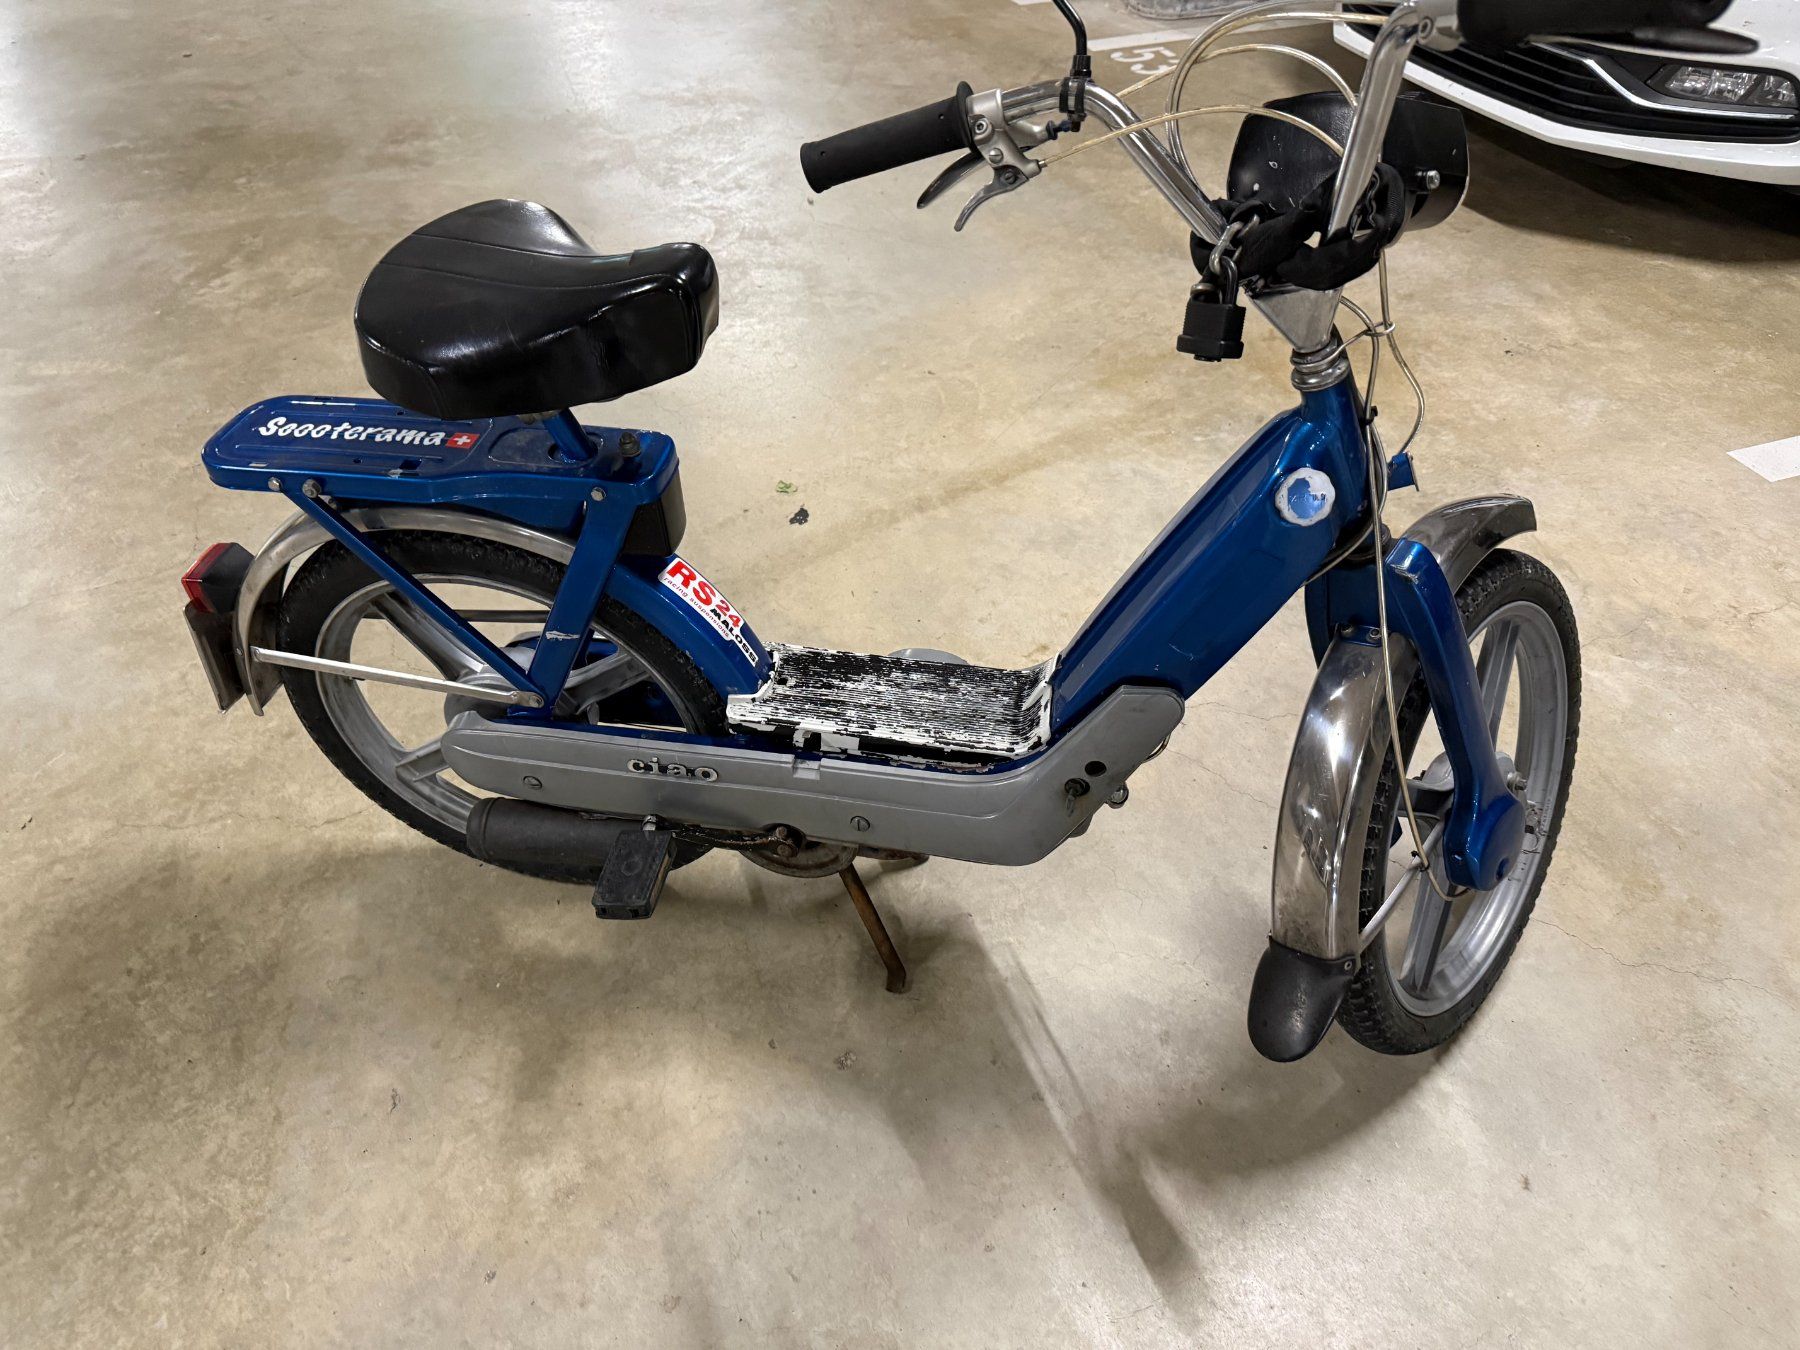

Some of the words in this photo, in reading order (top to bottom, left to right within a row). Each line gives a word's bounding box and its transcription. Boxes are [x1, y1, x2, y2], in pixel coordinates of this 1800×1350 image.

[663, 577, 689, 598] racing
[689, 597, 730, 638] suspensions
[626, 757, 719, 782] ciao
